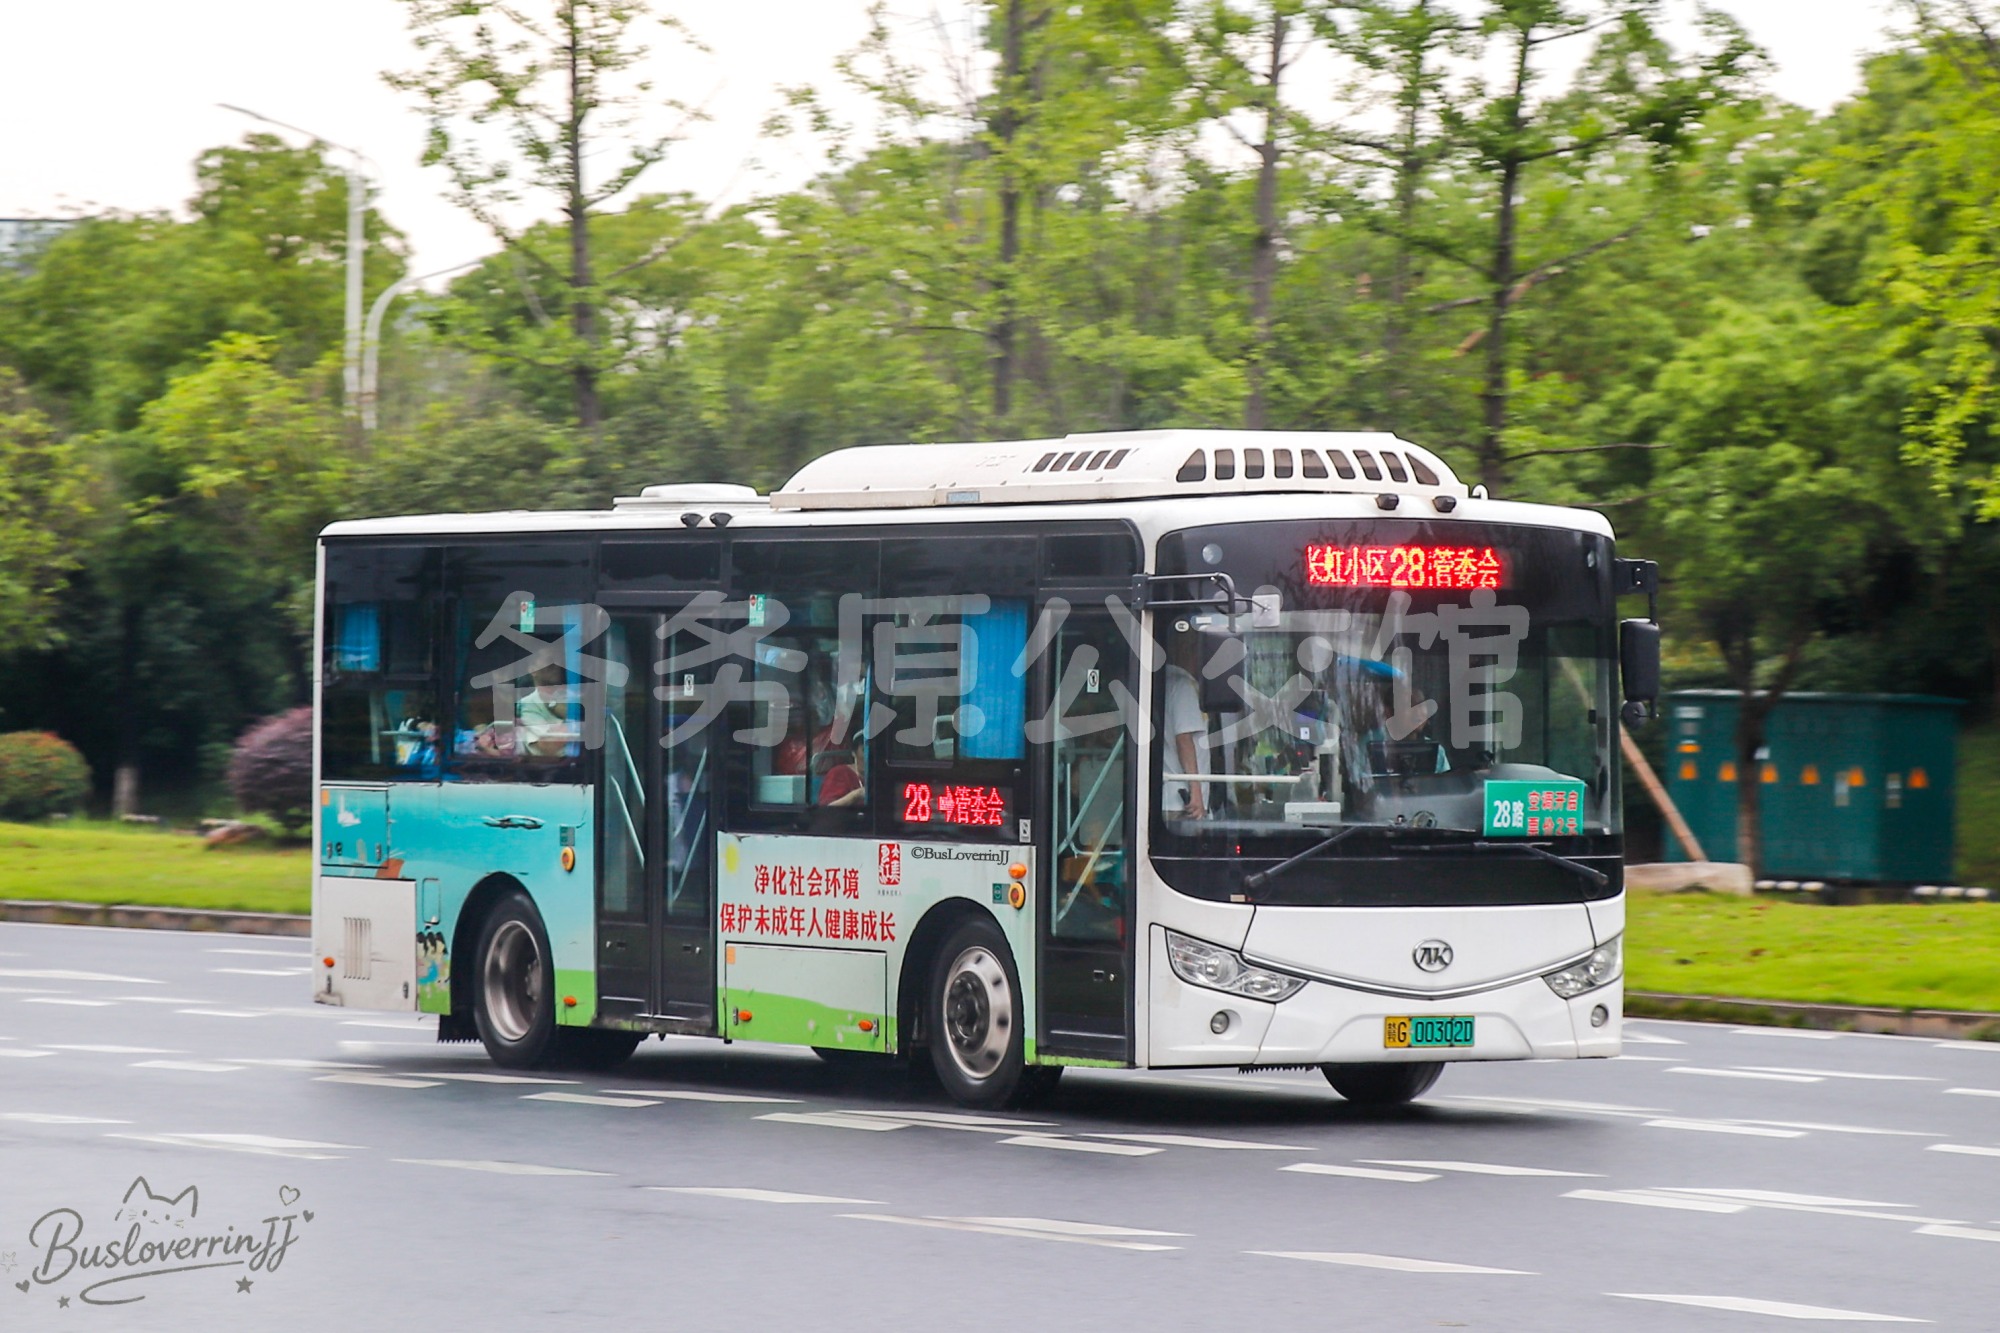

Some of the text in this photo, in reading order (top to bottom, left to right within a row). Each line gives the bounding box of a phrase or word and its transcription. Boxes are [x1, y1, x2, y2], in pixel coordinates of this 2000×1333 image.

[1307, 545, 1500, 588] 长虹小区 28 管委会
[904, 783, 1005, 825] 28 管委会
[1493, 800, 1525, 828] 28路
[1528, 790, 1579, 811] 空调开启
[754, 865, 860, 899] 净化社会环境
[720, 903, 896, 942] 保护未成年人健康成长
